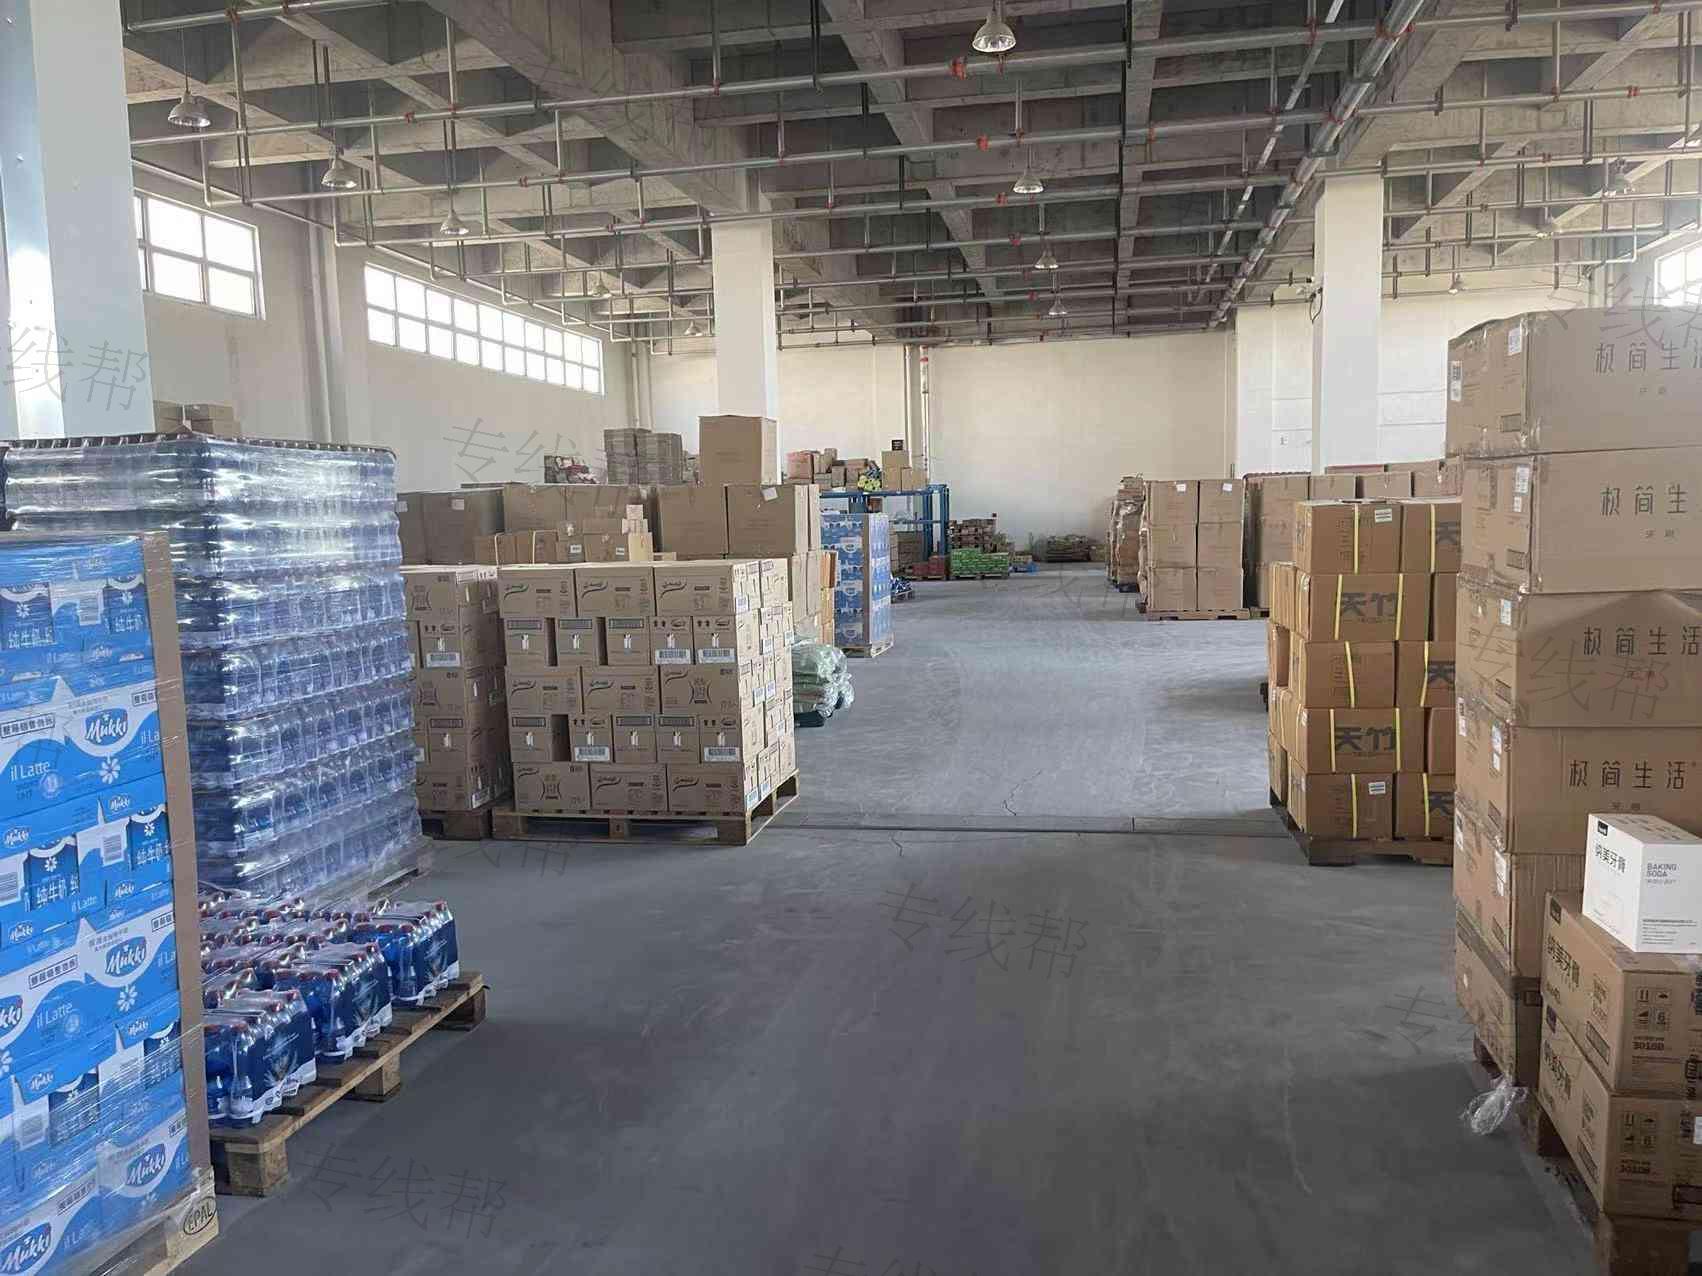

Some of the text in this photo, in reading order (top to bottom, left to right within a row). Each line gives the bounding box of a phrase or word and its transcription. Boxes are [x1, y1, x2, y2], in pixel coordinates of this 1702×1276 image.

[1436, 521, 1460, 546] 天
[1583, 625, 1702, 656] 极简生活
[1428, 661, 1456, 685] 天
[86, 717, 127, 743] Mukki
[11, 761, 50, 781] il Latte
[1569, 760, 1686, 790] 极简生活
[1647, 863, 1678, 871] BAKING
[106, 946, 146, 974] Mukki
[0, 1004, 21, 1029] kki
[127, 1153, 165, 1186] Mukki
[1, 1235, 50, 1273] Mukki
